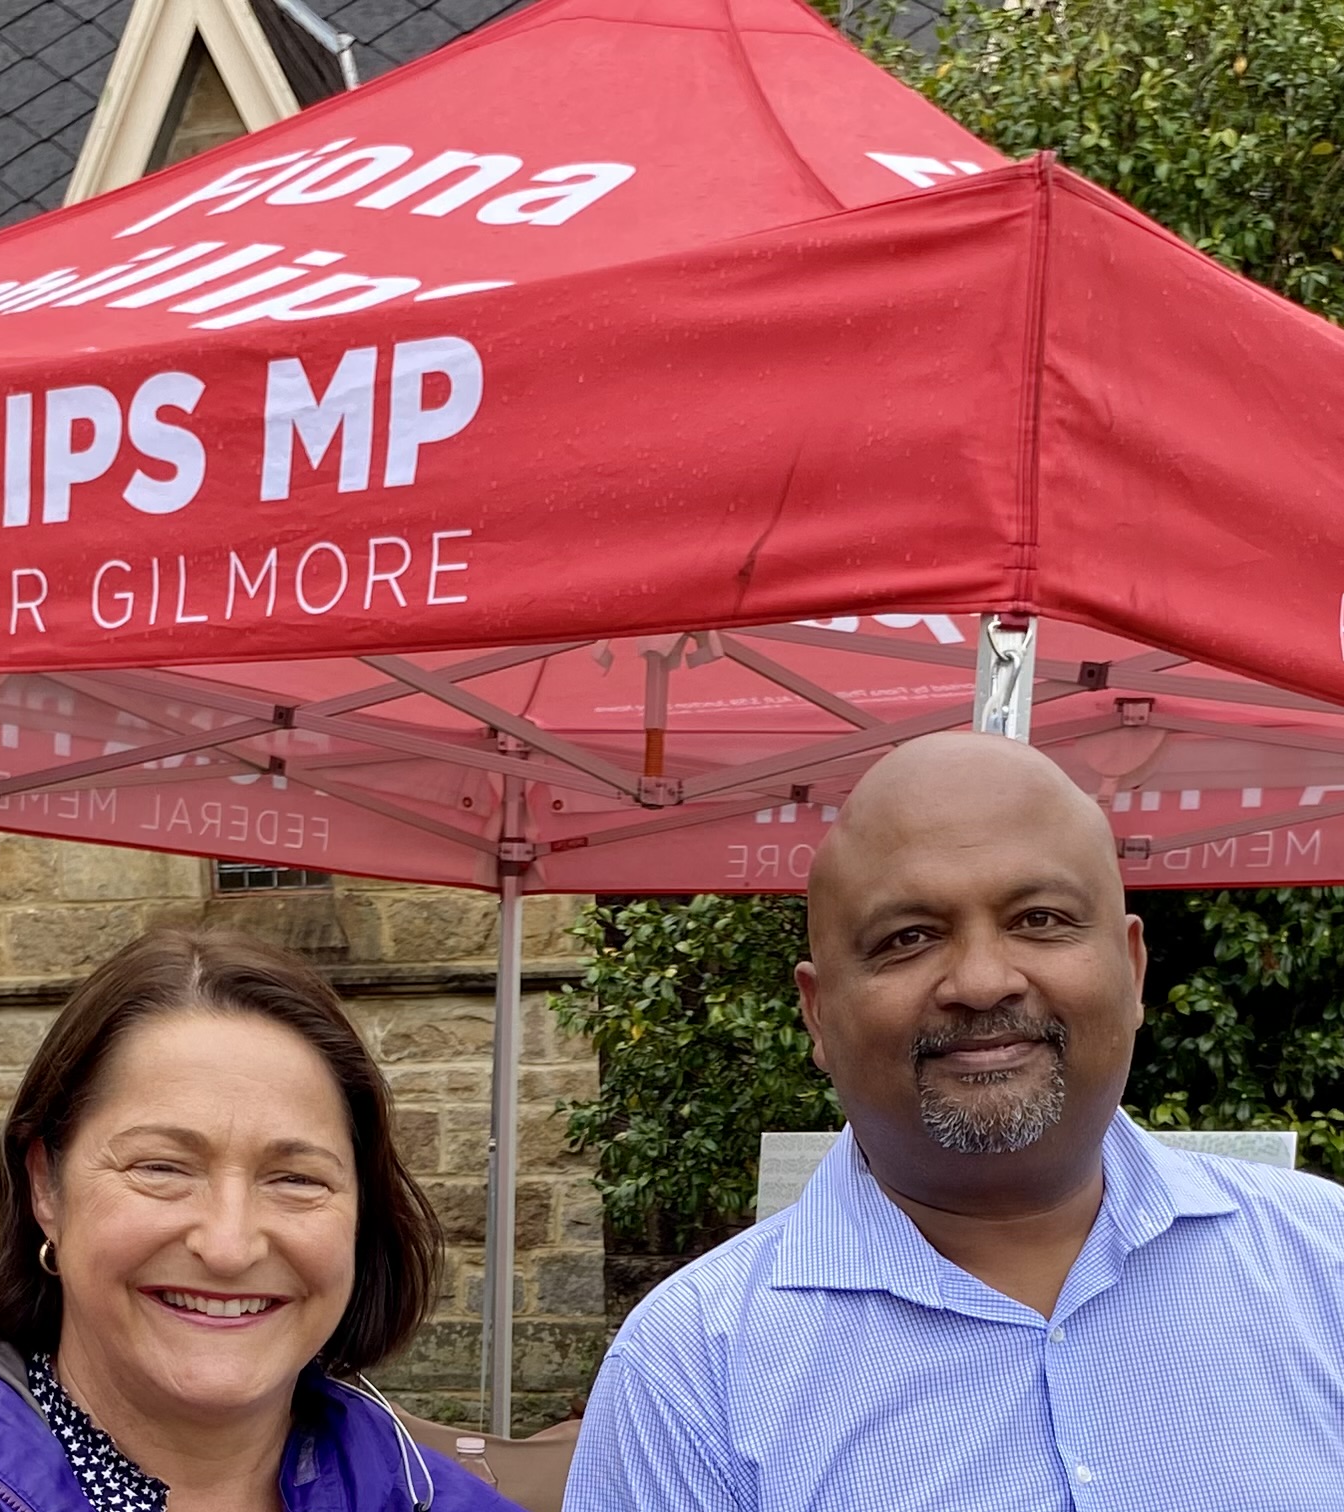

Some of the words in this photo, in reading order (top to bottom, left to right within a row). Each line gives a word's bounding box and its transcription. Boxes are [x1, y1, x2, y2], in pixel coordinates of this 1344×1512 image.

[112, 137, 636, 238] Fiona
[261, 336, 483, 500] MP
[92, 530, 472, 630] GILMORE
